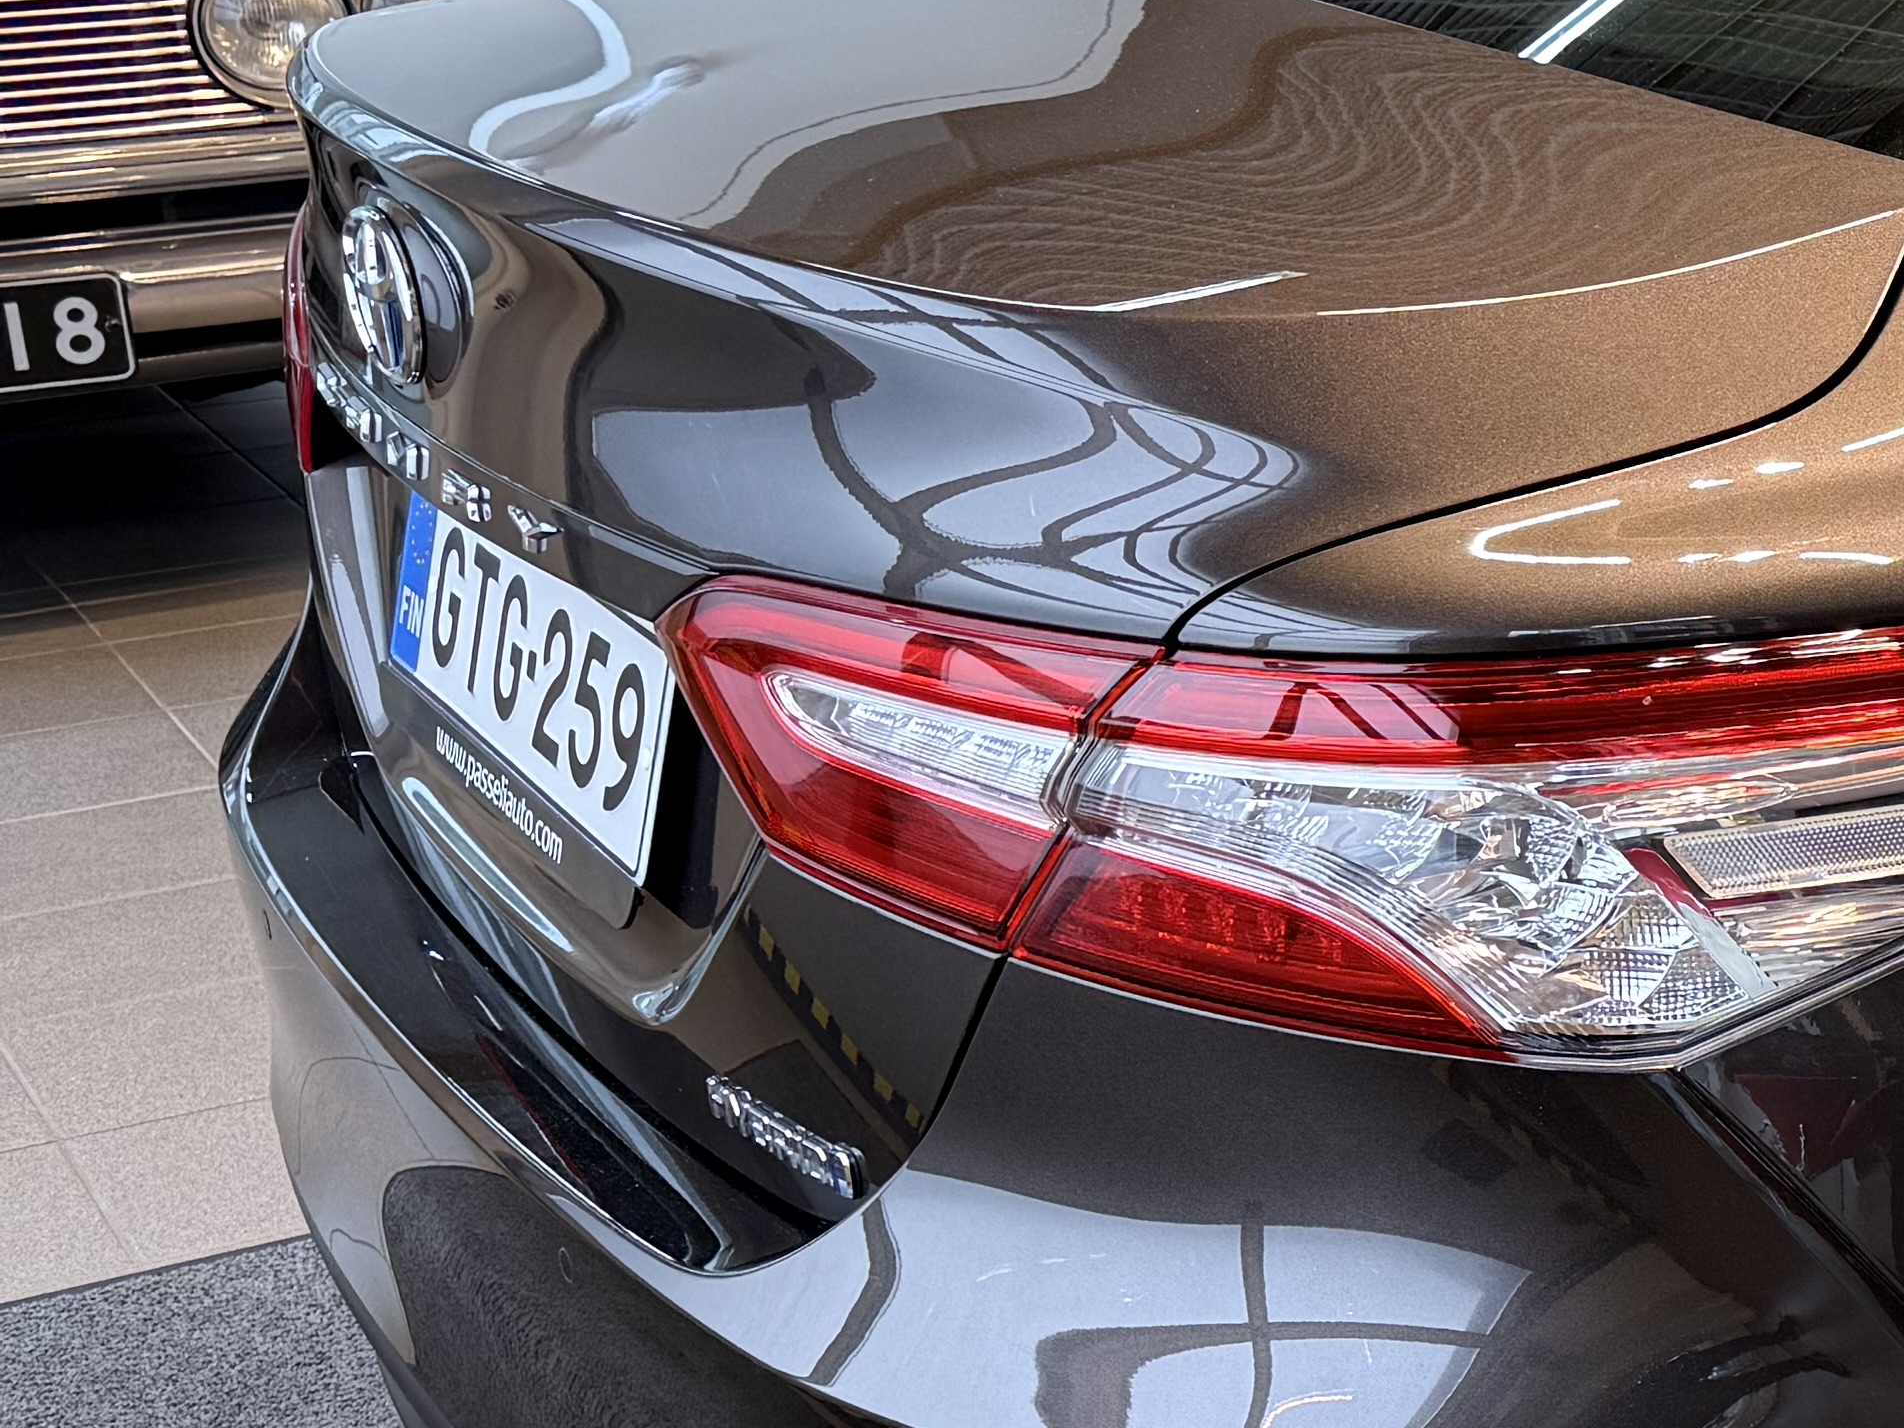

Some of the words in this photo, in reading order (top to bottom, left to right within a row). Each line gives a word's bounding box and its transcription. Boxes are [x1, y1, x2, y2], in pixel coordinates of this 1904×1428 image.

[316, 362, 566, 554] CAMRY
[398, 584, 426, 640] FIN
[431, 526, 647, 812] GTG-259
[435, 724, 564, 865] www.passeliauto.com
